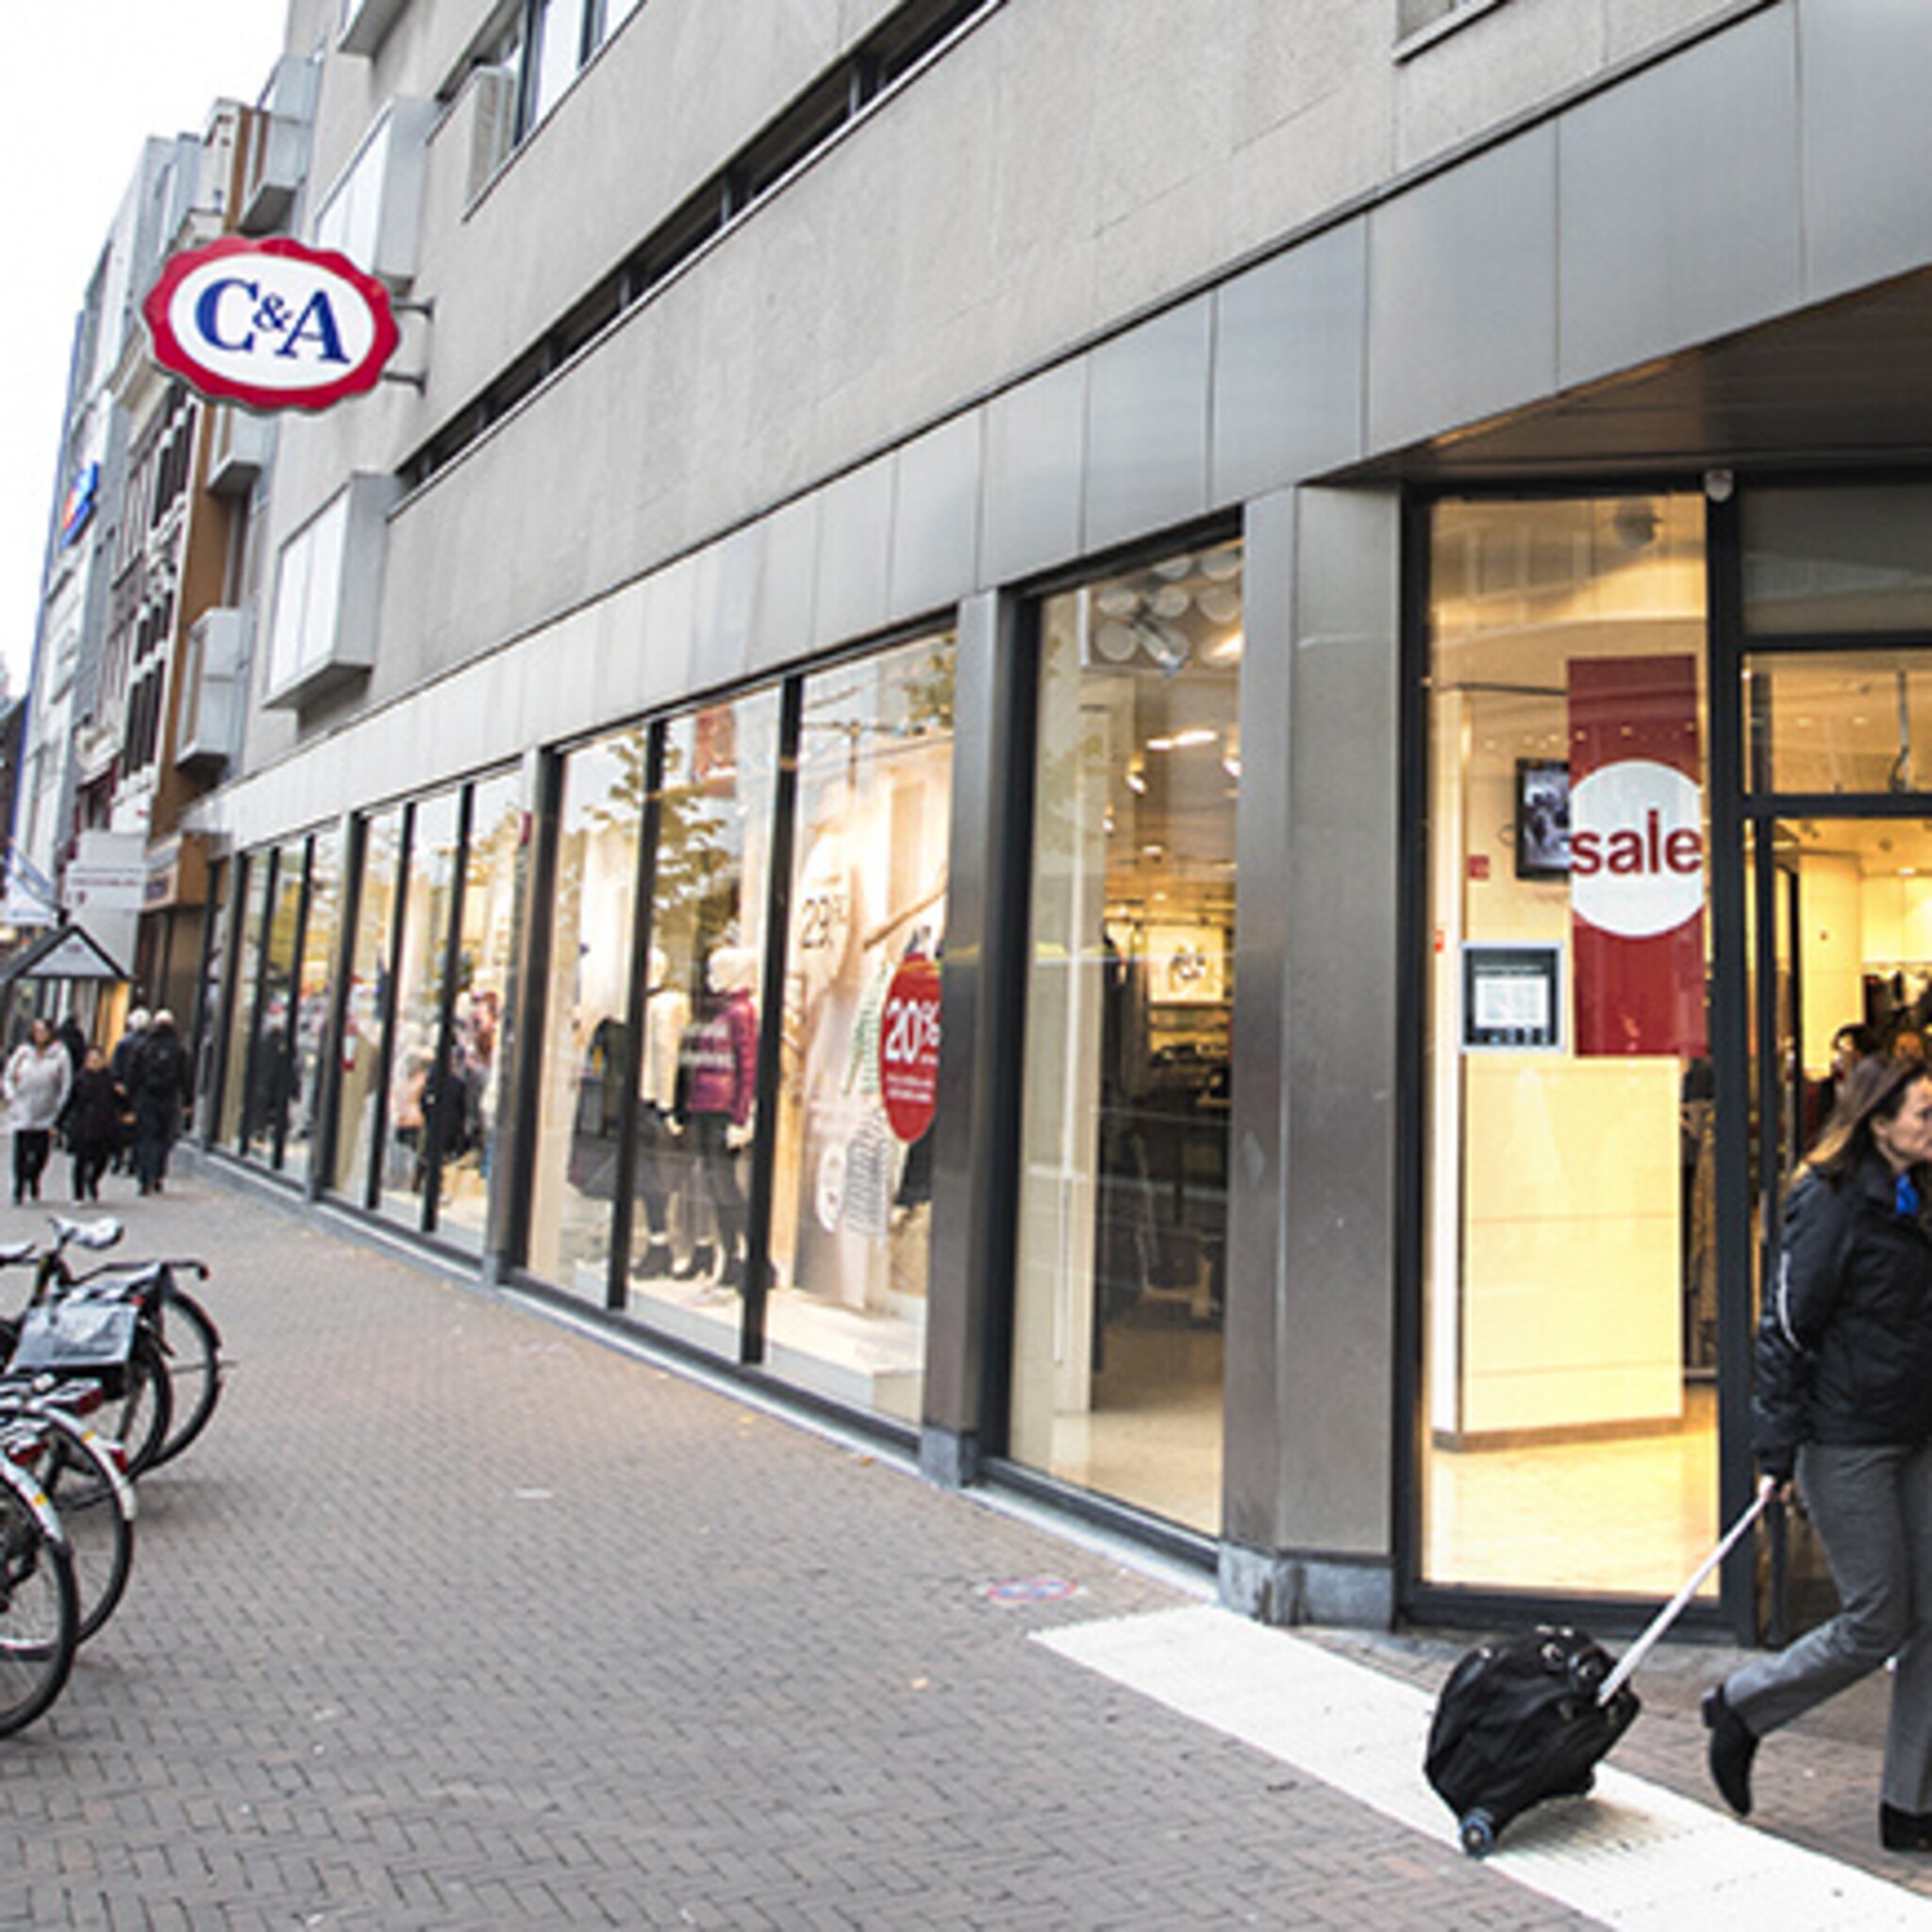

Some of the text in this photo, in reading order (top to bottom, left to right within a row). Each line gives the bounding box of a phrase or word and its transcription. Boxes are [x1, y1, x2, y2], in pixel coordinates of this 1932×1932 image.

[195, 277, 352, 365] C&A
[1571, 808, 1703, 877] sale
[885, 998, 942, 1064] 20%
